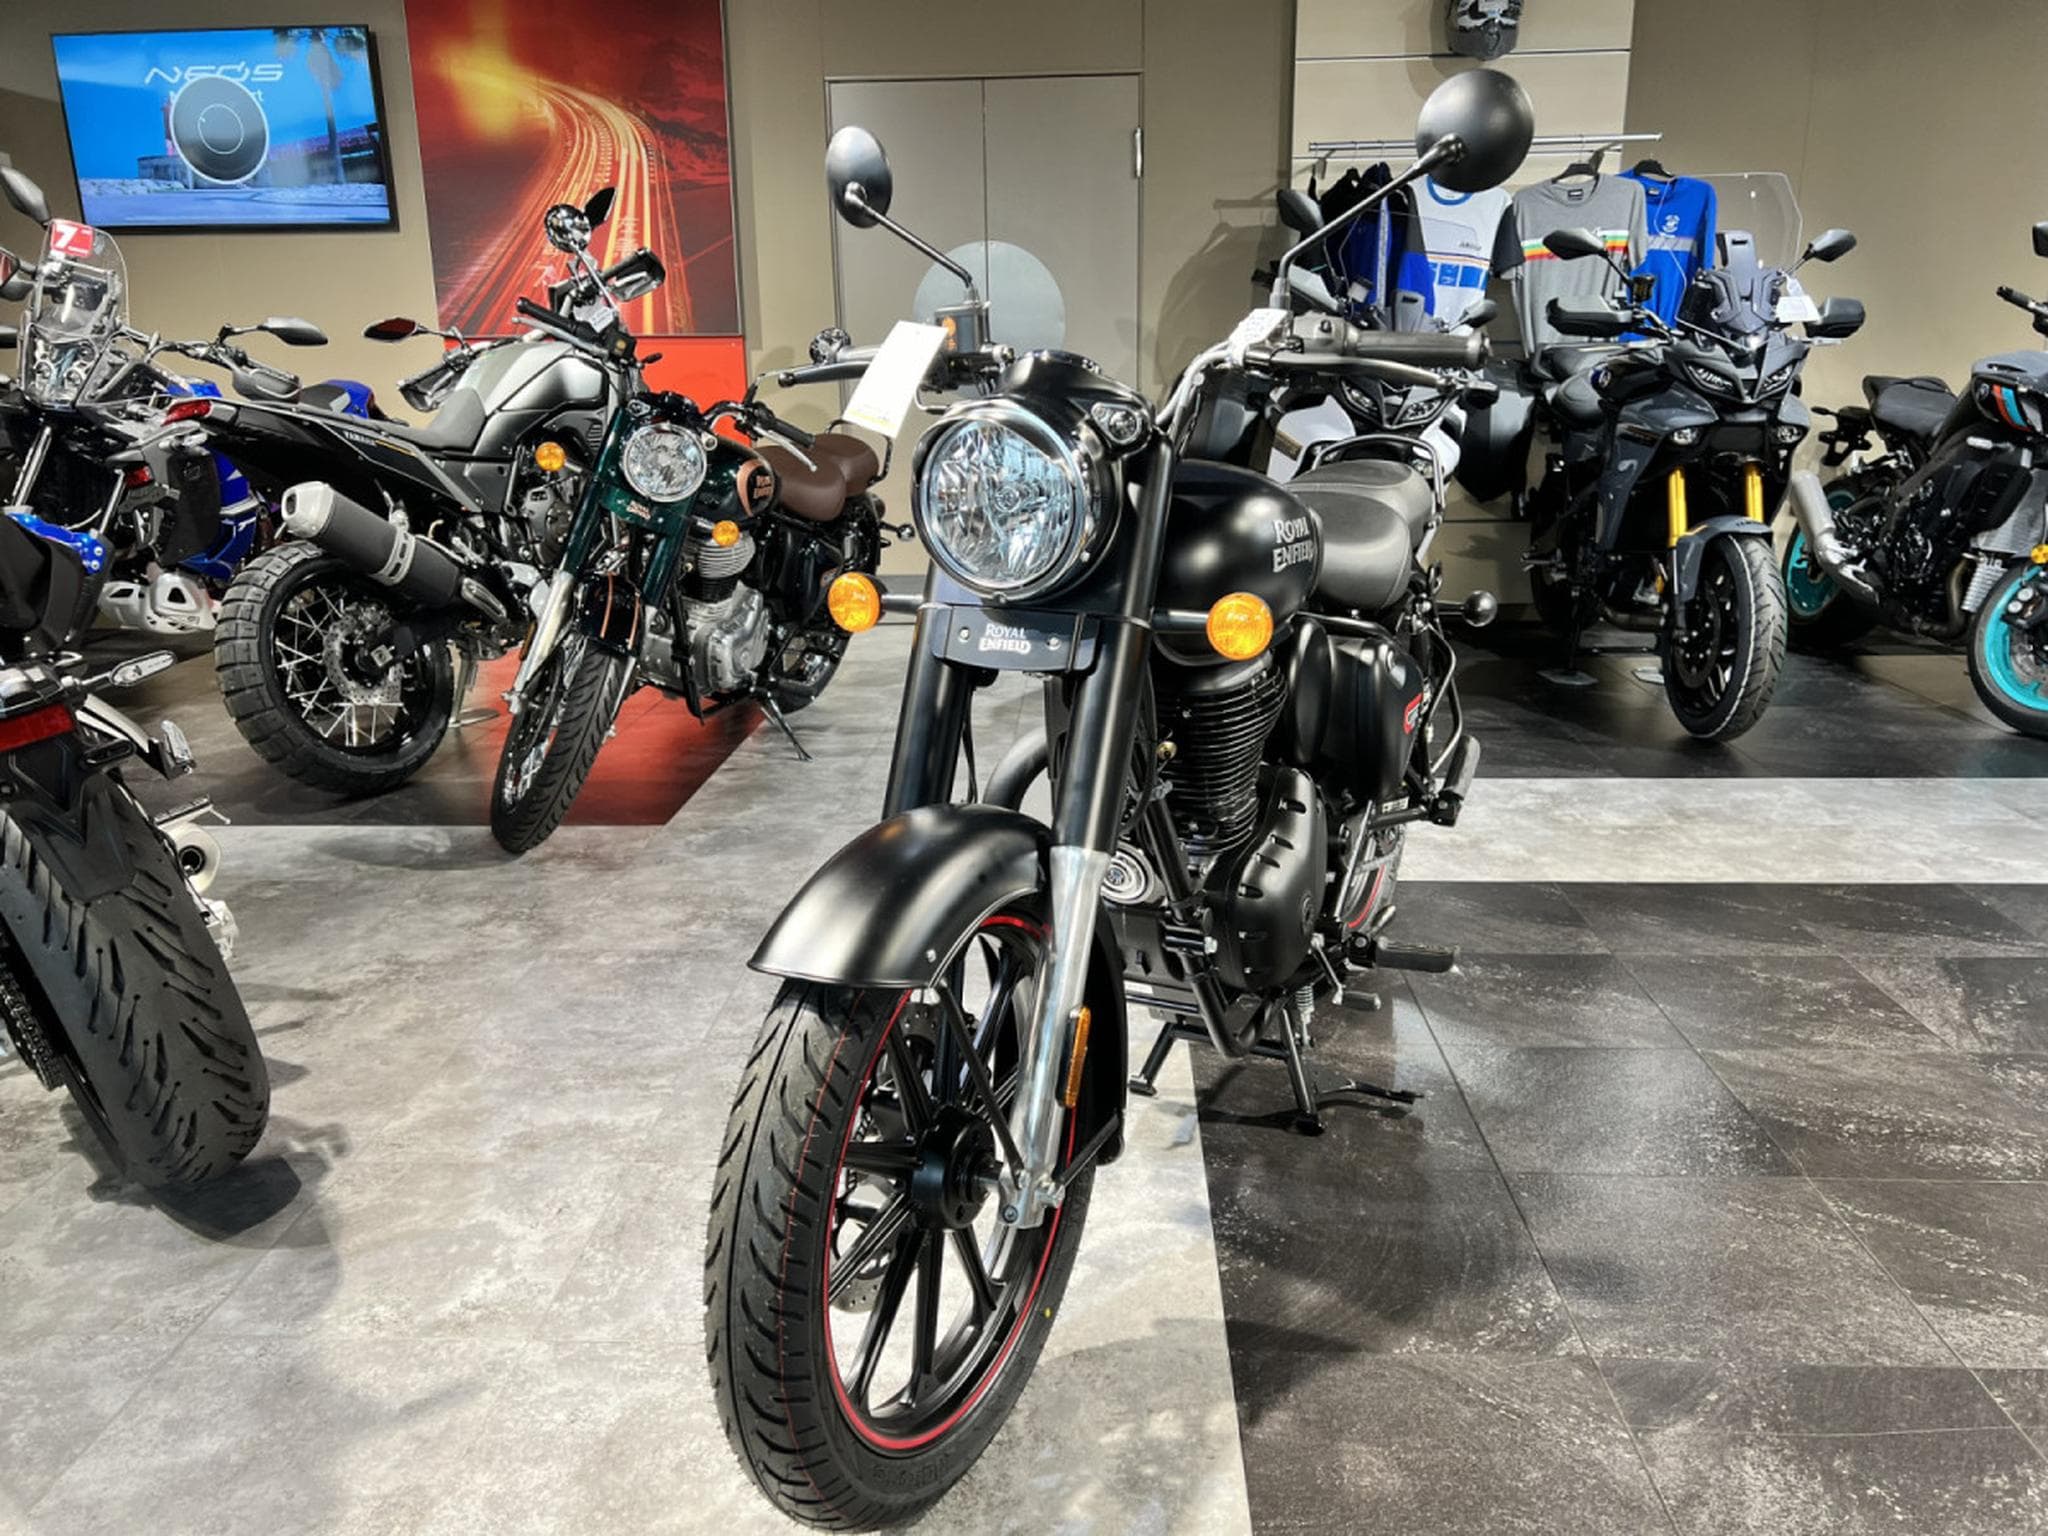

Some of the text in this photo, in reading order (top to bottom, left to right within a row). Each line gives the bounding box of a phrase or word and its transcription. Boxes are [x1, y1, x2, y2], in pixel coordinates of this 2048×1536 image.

[144, 61, 284, 84] NEOS
[1273, 516, 1310, 544] ROYAL
[985, 622, 1027, 640] ROYAL
[978, 637, 1032, 655] ENFIELD
